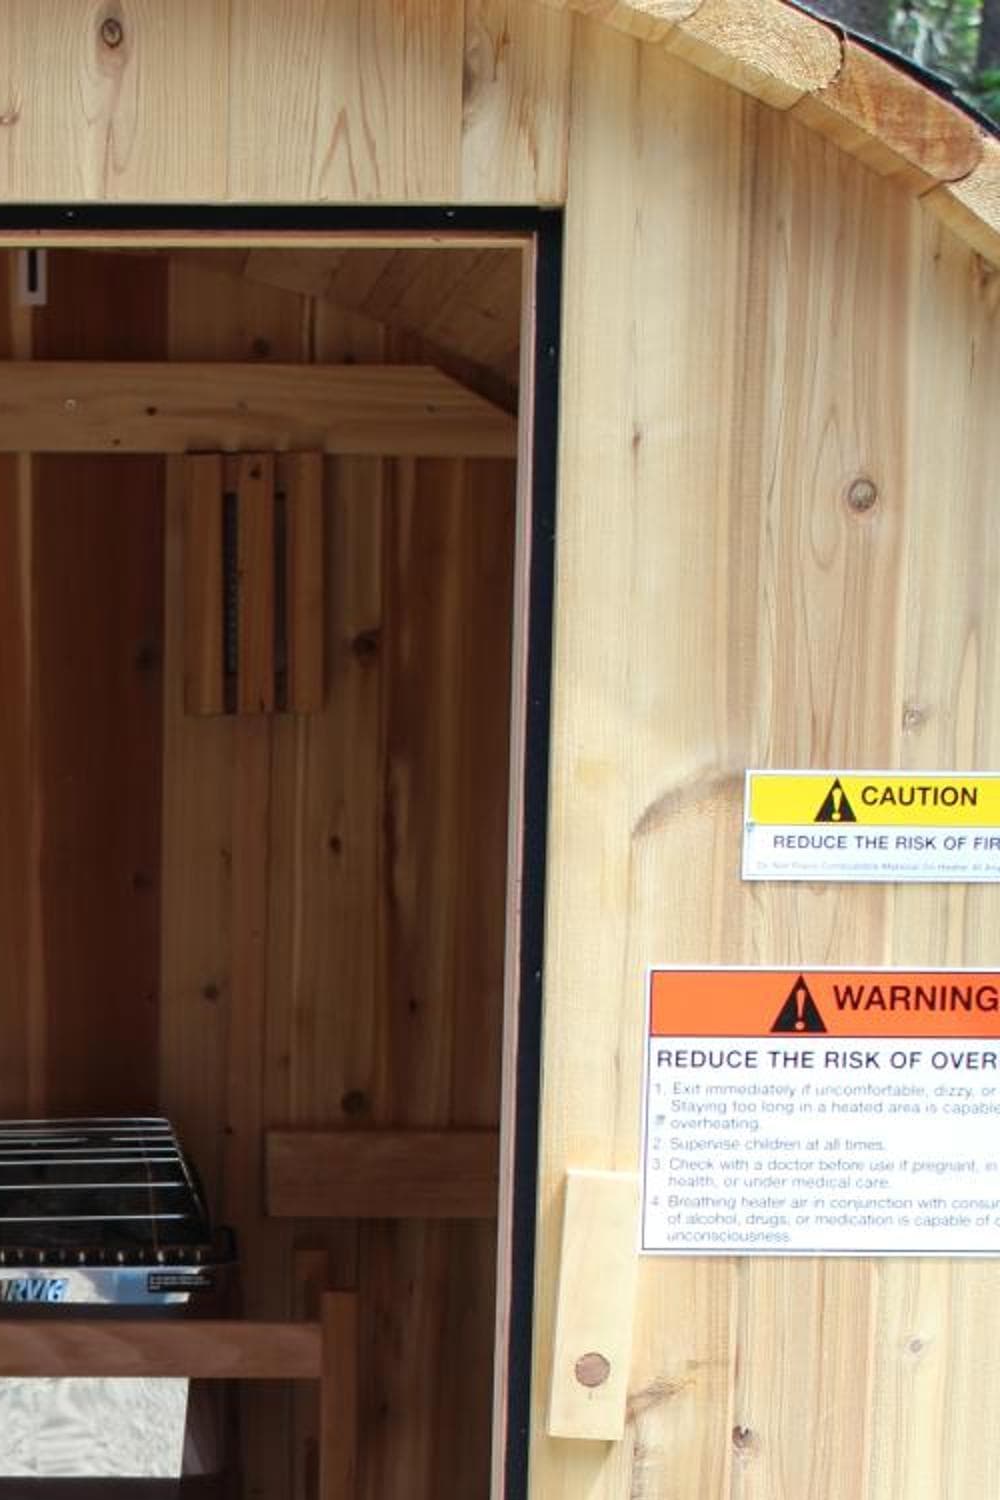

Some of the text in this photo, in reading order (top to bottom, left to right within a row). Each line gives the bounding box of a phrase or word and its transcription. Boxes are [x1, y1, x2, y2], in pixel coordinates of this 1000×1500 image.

[861, 785, 978, 807] CAUTION
[773, 835, 848, 849] REDUCE
[854, 836, 889, 849] THE
[895, 836, 936, 850] RISK
[943, 836, 968, 850] OF
[833, 984, 999, 1012] WARNING
[657, 1049, 997, 1070] REDUCE THE RISK OF OVER
[673, 1081, 700, 1095] Exit
[705, 1083, 796, 1100] immediately
[801, 1083, 811, 1096] if
[815, 1083, 929, 1099] uncomfortable,
[981, 1086, 997, 1097] or
[671, 1099, 727, 1114] Staying
[732, 1100, 756, 1113] too
[761, 1100, 794, 1115] long
[800, 1101, 812, 1113] in
[818, 1103, 826, 1113] a
[831, 1101, 883, 1113] heated
[888, 1103, 920, 1114] area
[925, 1102, 938, 1114] is
[669, 1137, 741, 1151] Supervise
[744, 1137, 800, 1150] children
[805, 1138, 819, 1150] at
[824, 1138, 840, 1150] all
[845, 1138, 886, 1150] times.
[669, 1157, 713, 1170] Check
[719, 1158, 749, 1171] with
[754, 1160, 763, 1170] a
[767, 1158, 814, 1171] doctor
[819, 1159, 865, 1171] before
[869, 1161, 895, 1172] use
[723, 1177, 738, 1188] or
[743, 1176, 787, 1188] under
[791, 1176, 851, 1189] medical
[667, 1195, 737, 1209] Breathing
[790, 1197, 808, 1209] air
[814, 1198, 824, 1208] in
[829, 1198, 913, 1211] conjunction
[917, 1198, 947, 1209] with
[667, 1212, 681, 1225] of
[685, 1212, 742, 1227] alcohol,
[795, 1215, 810, 1225] or
[814, 1213, 894, 1226] medication
[899, 1214, 910, 1226] is
[914, 1214, 971, 1228] capable
[976, 1214, 991, 1227] of
